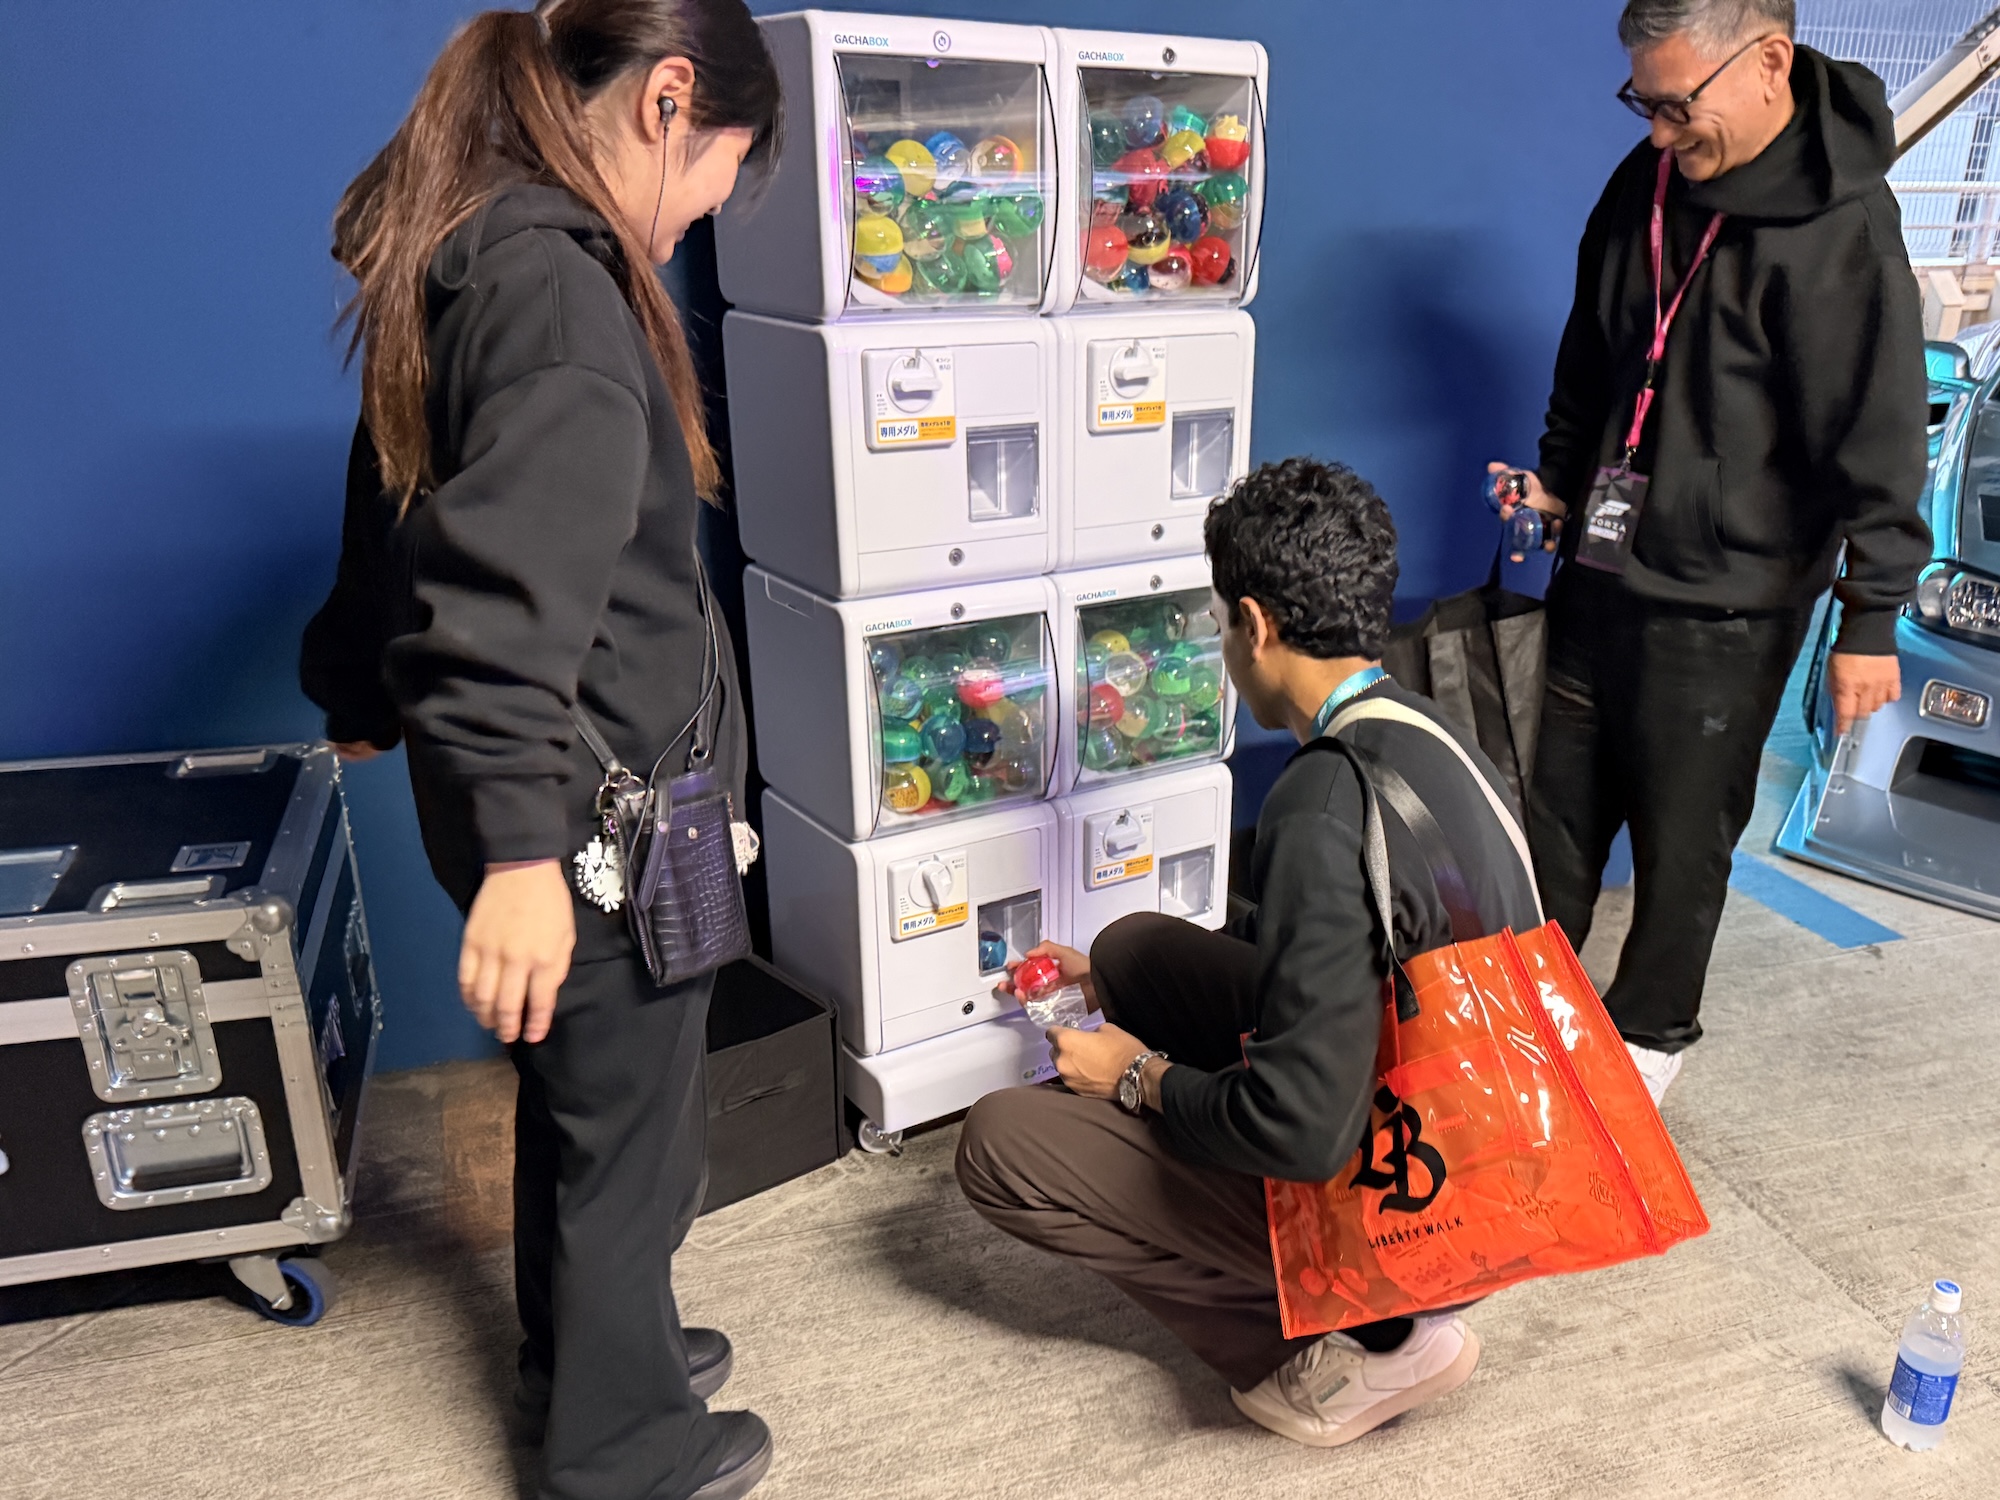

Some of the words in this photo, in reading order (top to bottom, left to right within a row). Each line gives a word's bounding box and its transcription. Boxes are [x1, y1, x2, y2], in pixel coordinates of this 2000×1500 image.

[834, 34, 889, 47] GACHABOX
[1078, 50, 1125, 62] GACHABOX
[880, 425, 918, 438] 専用メダル
[1076, 589, 1117, 602] GACHABOX
[865, 619, 913, 632] GACHABOX
[1368, 1227, 1420, 1249] LIBERTY
[1424, 1216, 1464, 1234] WALK
